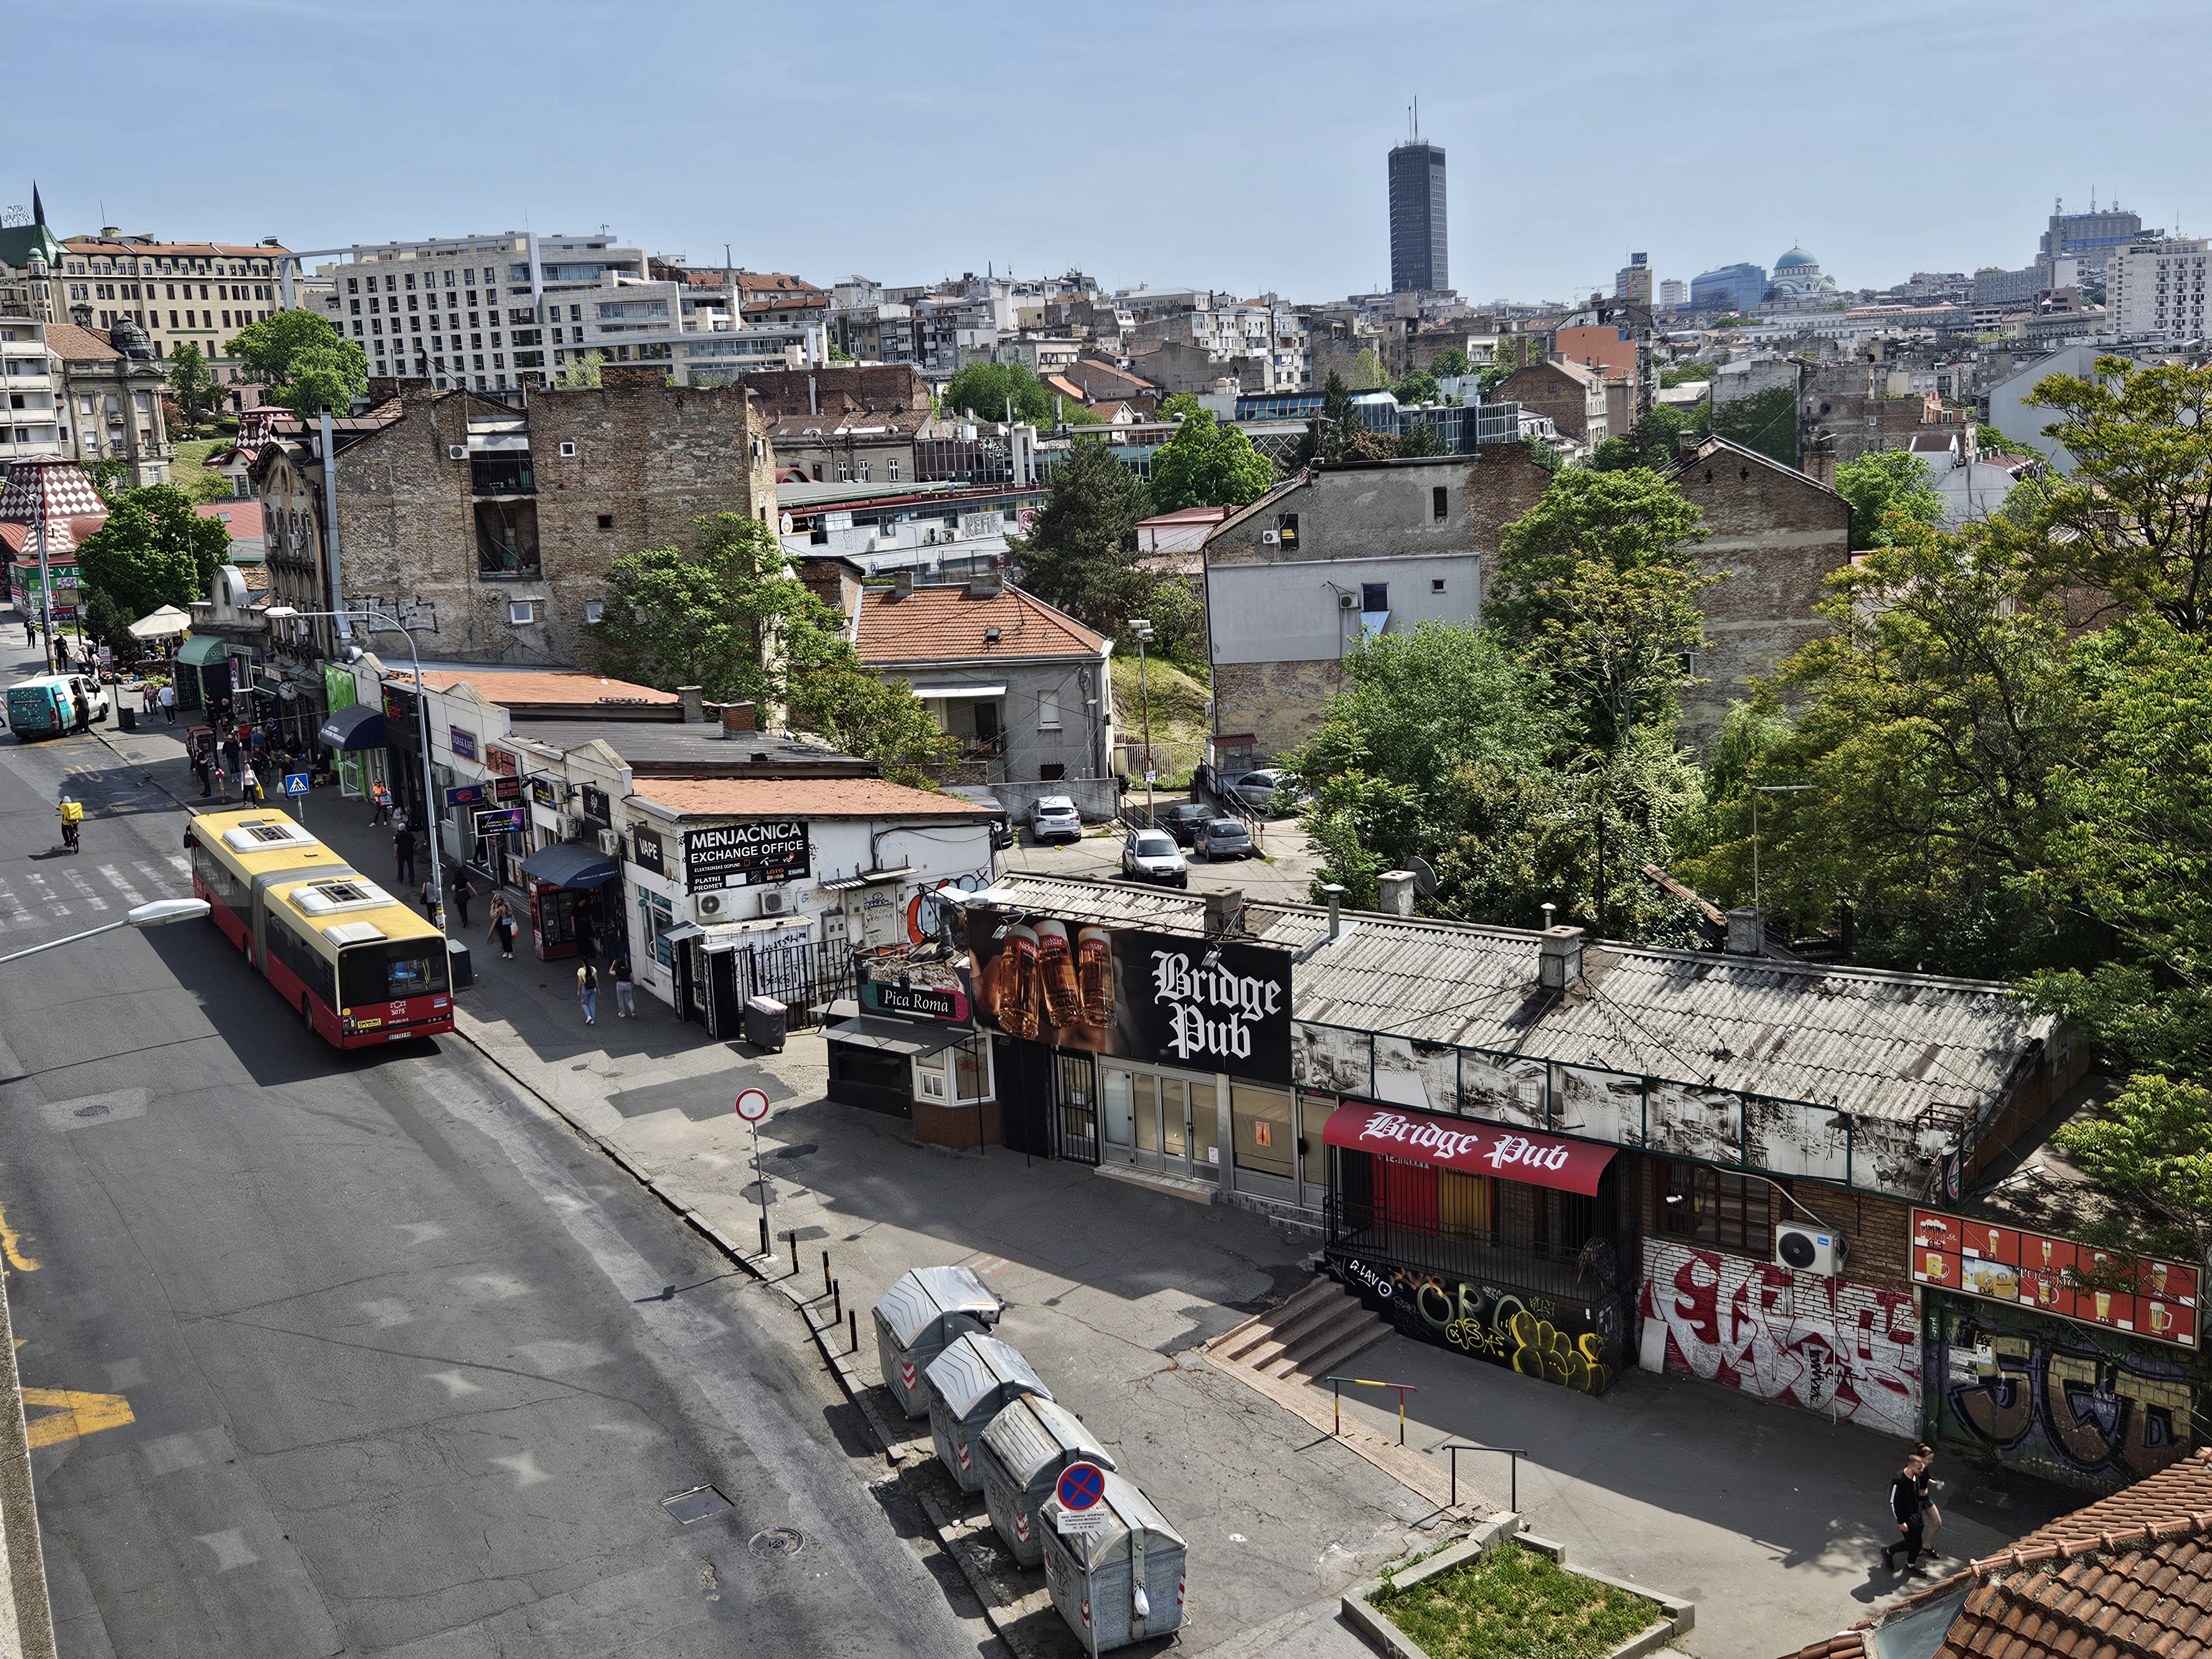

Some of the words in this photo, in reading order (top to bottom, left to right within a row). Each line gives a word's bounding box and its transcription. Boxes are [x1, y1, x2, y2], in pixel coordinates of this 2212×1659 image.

[691, 822, 802, 849] MENJAČNICA
[639, 837, 658, 860] VAPE
[691, 846, 759, 864] EXCHANGE
[761, 839, 804, 854] OFFICE
[694, 882, 723, 891] PROMET
[695, 875, 721, 884] PLATNI
[1151, 950, 1282, 1021] Bridge
[884, 990, 910, 1006] Pica
[913, 994, 949, 1012] Roma
[1168, 1002, 1251, 1059] Pub
[1359, 1112, 1479, 1159] Bridge
[1483, 1134, 1569, 1171] Pub
